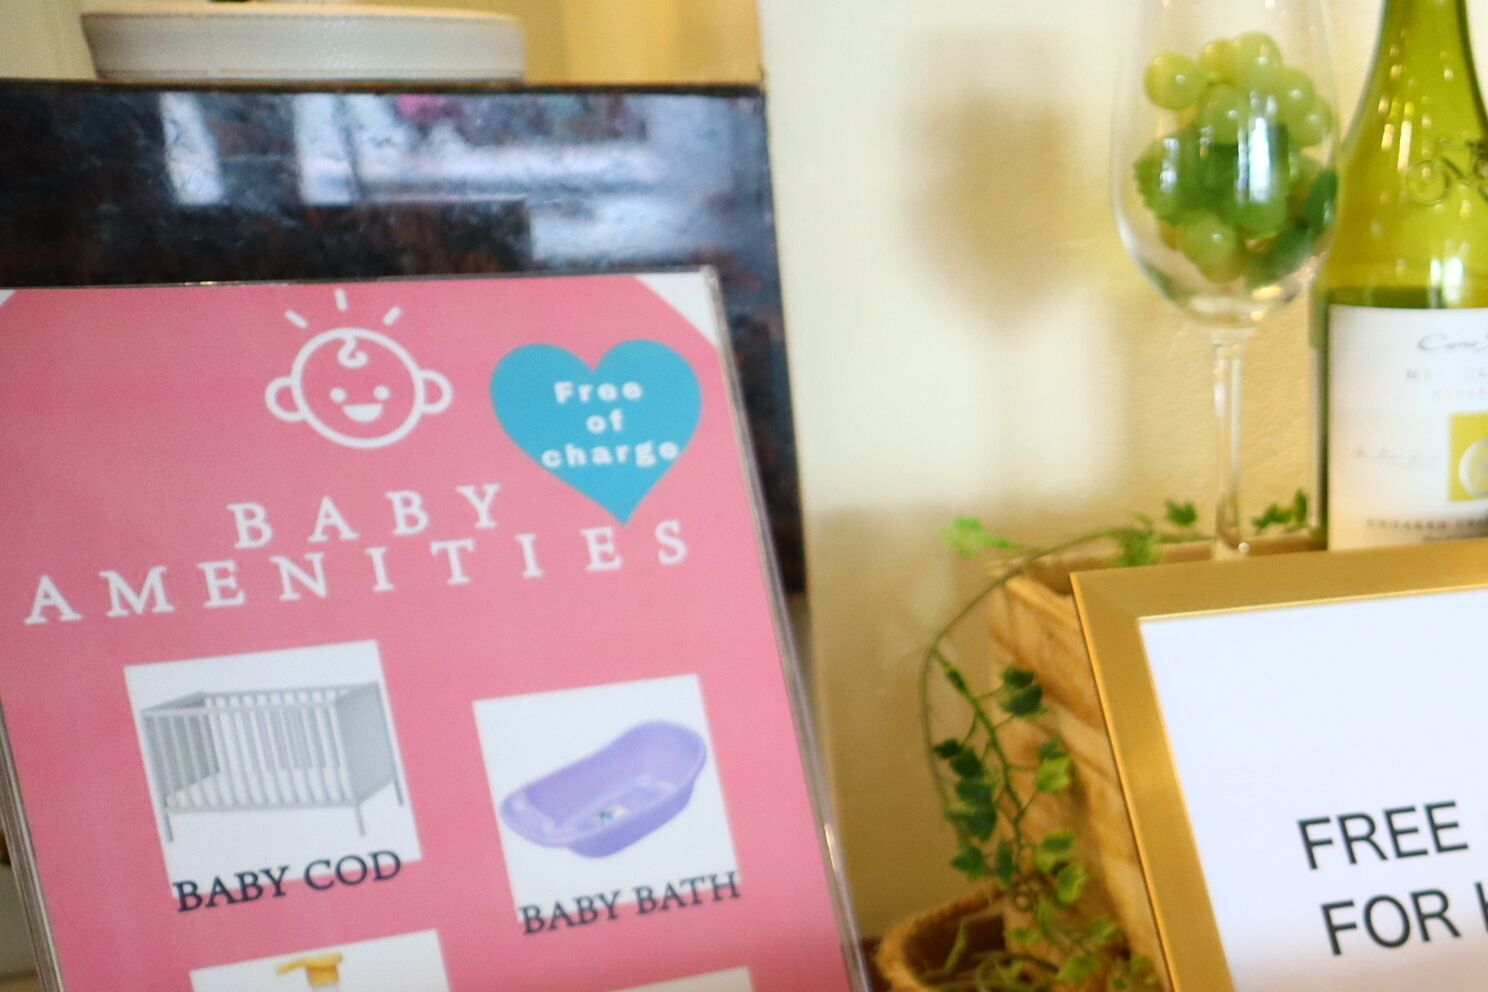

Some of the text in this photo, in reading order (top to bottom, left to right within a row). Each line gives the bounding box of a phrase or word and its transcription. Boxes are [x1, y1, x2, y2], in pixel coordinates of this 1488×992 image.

[553, 381, 642, 404] Free
[585, 408, 624, 434] of
[541, 441, 679, 467] charge
[228, 483, 502, 549] BABY
[24, 520, 688, 625] AMENITIES
[1297, 801, 1468, 870] FREE
[172, 850, 402, 913] BABY COD
[520, 871, 741, 936] BABY BATH
[1320, 888, 1461, 956] FOR
